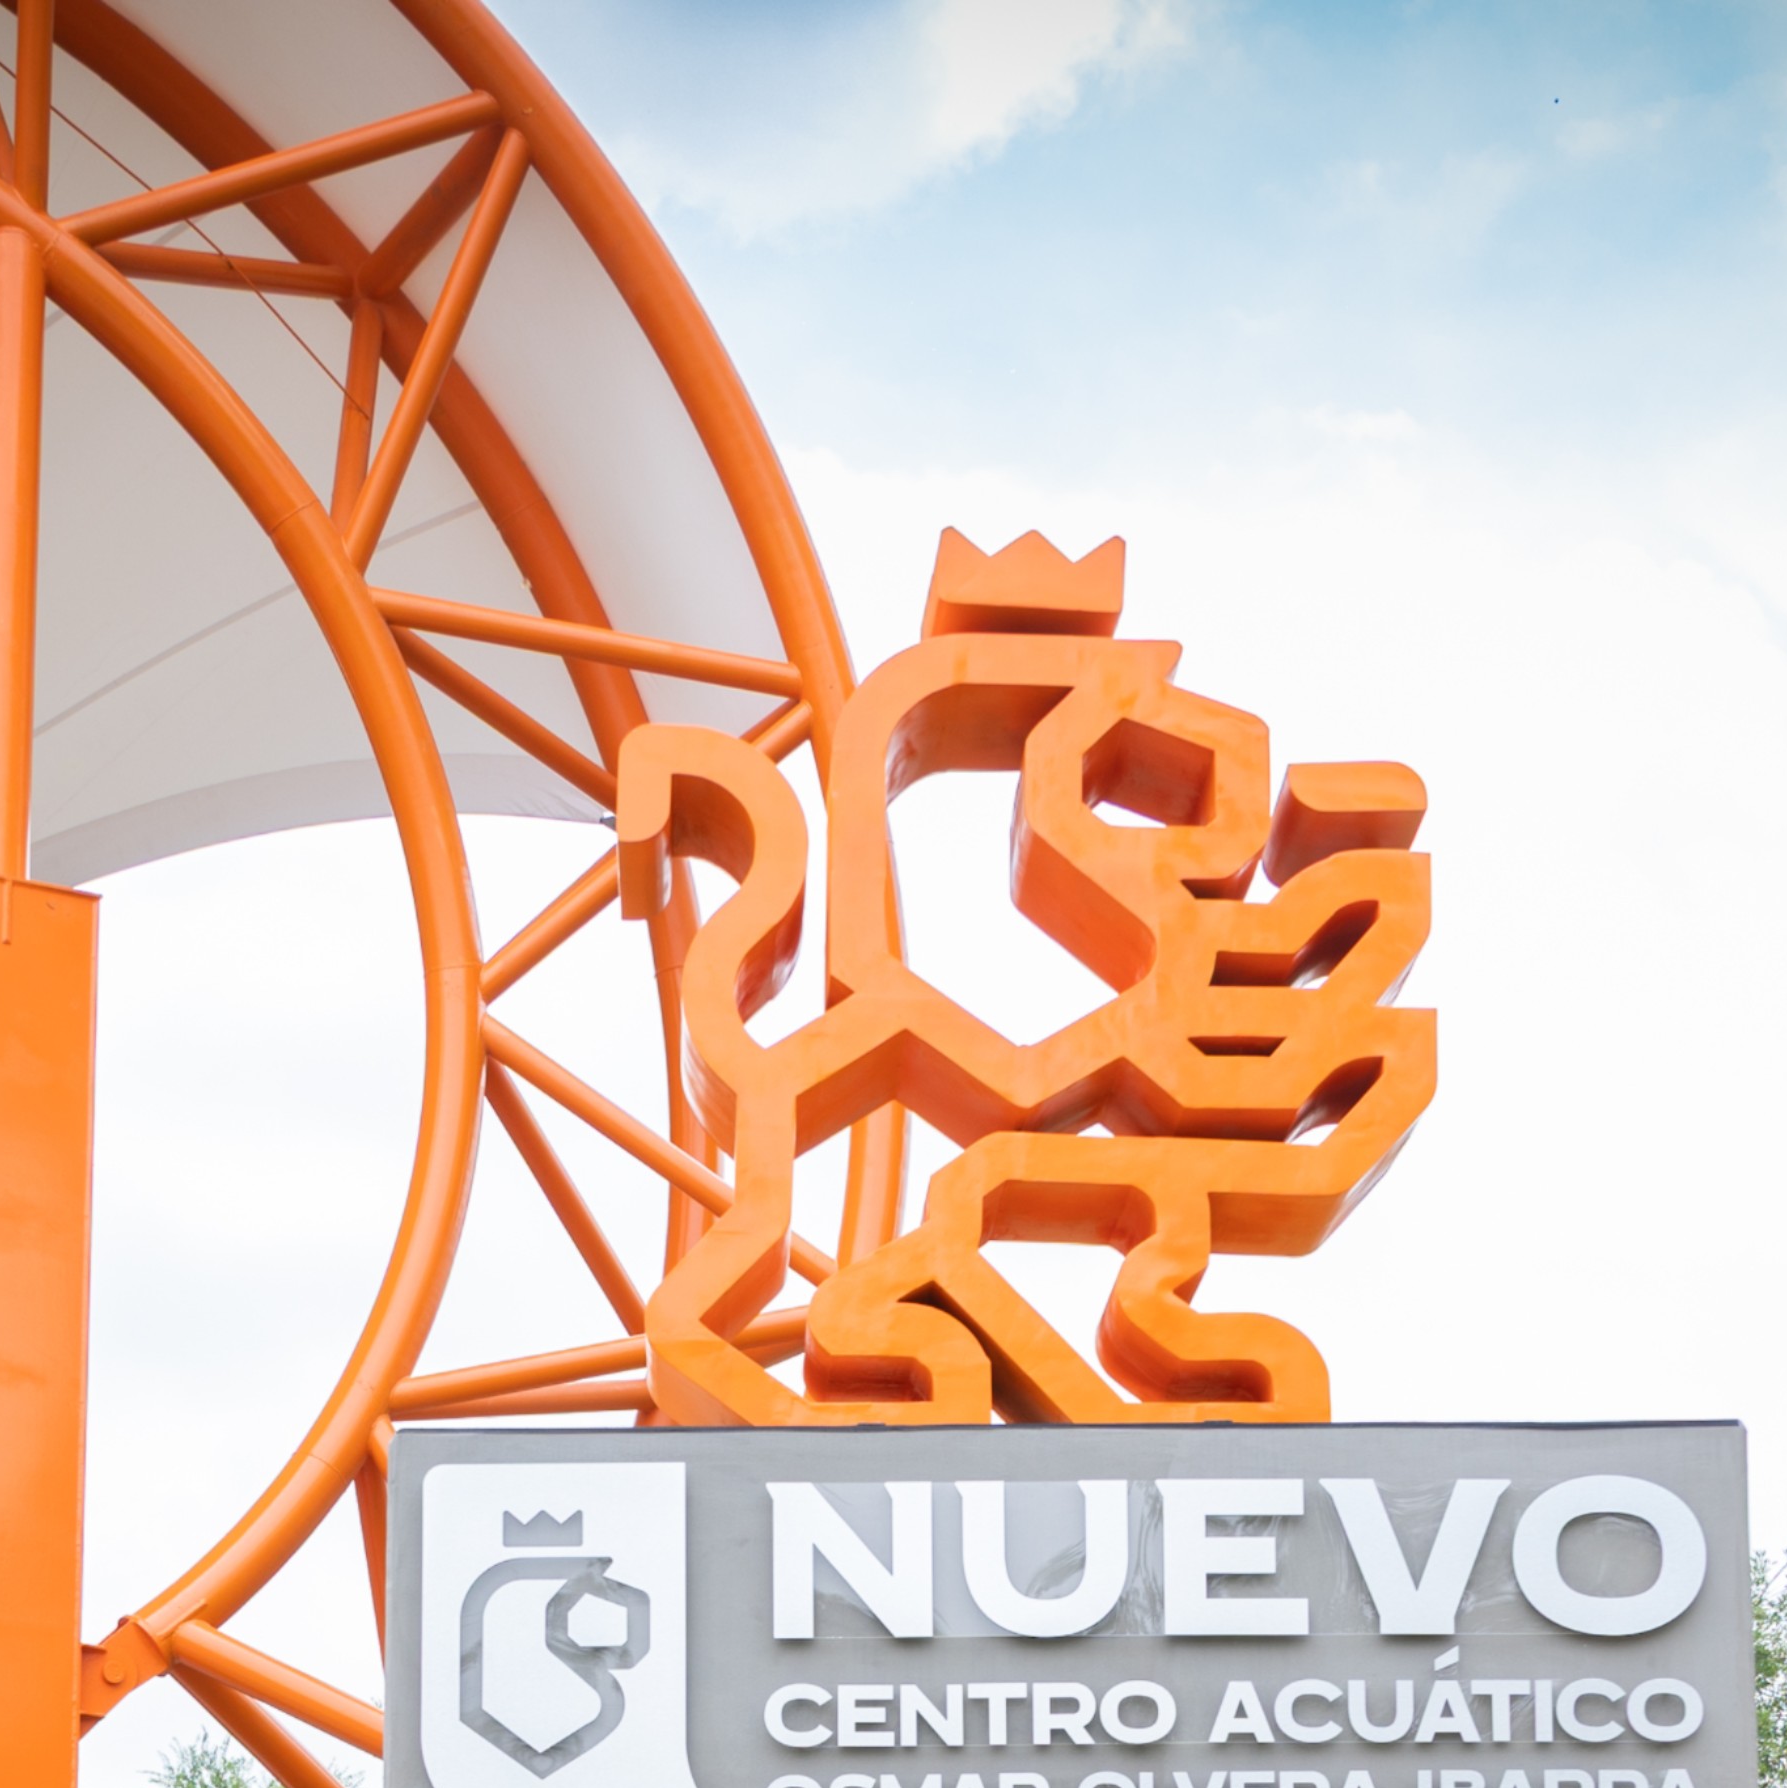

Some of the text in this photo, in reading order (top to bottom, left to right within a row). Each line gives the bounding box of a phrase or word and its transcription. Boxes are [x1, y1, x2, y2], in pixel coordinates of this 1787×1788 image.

[765, 1474, 1707, 1638] NUEVO
[763, 1645, 1704, 1748] CENTRO ACUÁTICO
